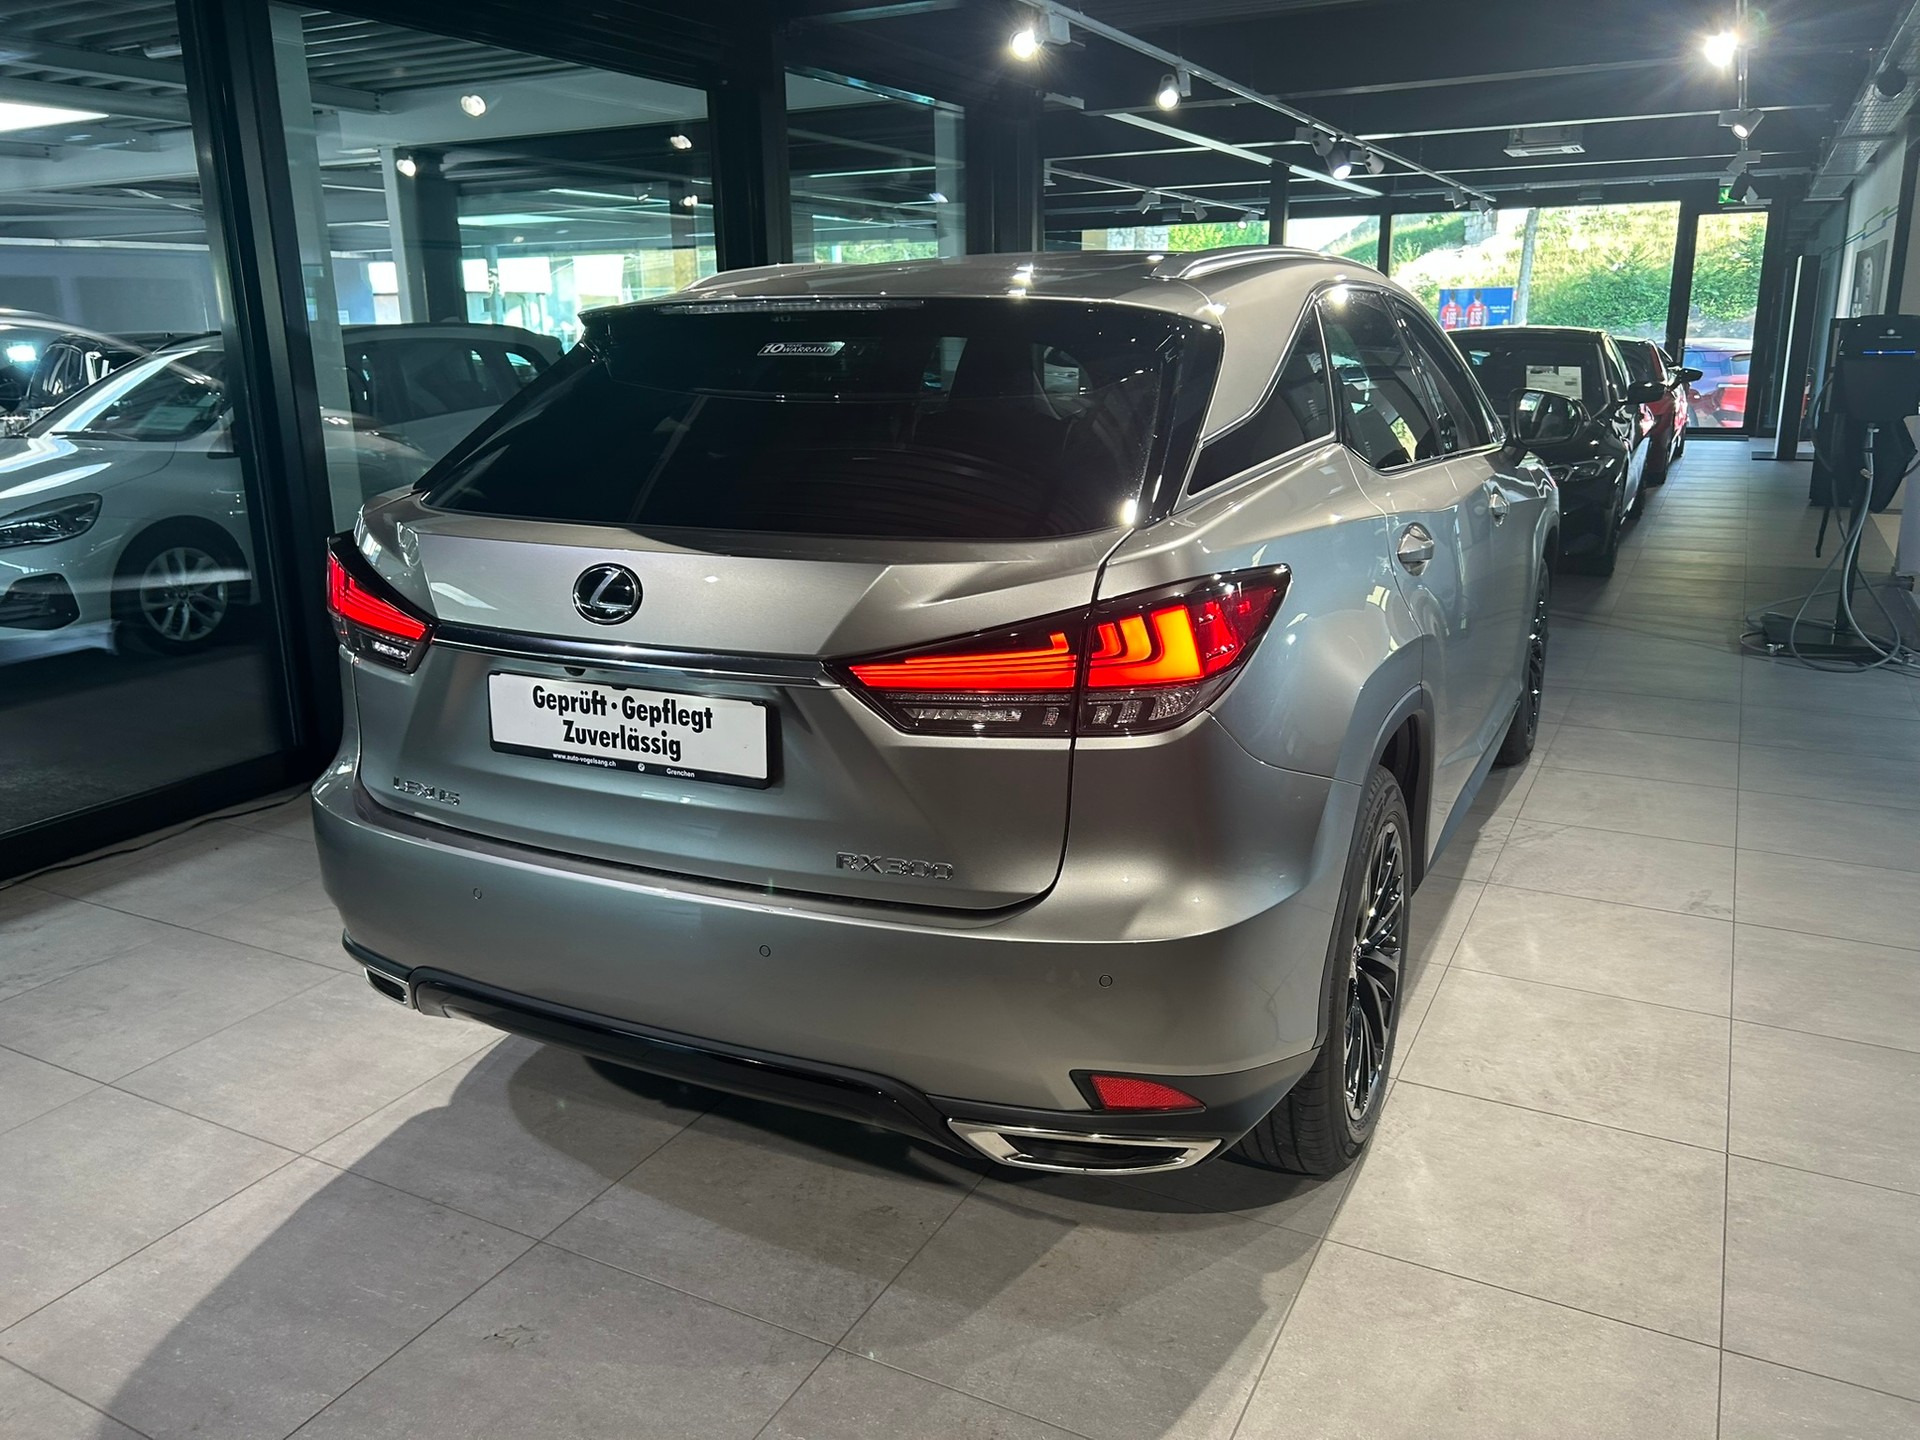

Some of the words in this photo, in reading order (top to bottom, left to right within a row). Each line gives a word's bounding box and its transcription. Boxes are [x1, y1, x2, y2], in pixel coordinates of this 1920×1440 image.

[763, 343, 785, 353] 10
[532, 685, 607, 717] Geprüft
[621, 695, 713, 734] Gepflegt
[562, 720, 681, 762] Zuverlässig
[552, 752, 617, 768] www.auto-vogelsang.ch
[666, 767, 695, 778] Grenchen
[393, 776, 461, 806] LEXUS
